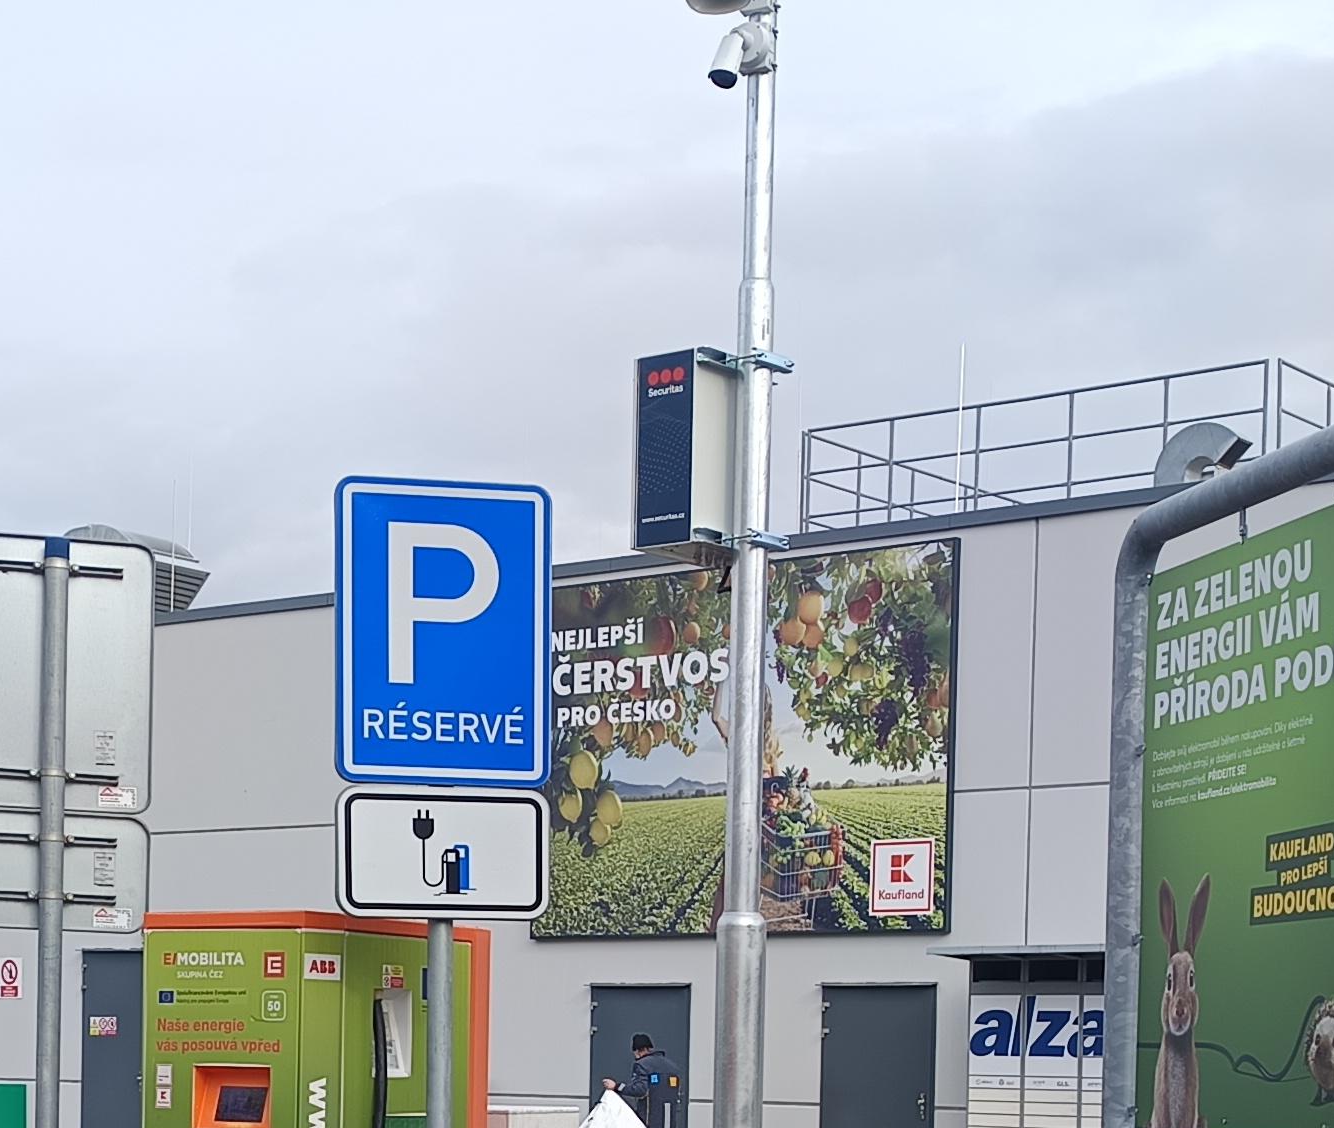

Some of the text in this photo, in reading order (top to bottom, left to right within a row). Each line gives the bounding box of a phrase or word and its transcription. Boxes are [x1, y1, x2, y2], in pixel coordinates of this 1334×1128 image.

[648, 384, 684, 397] Securitas
[1156, 539, 1312, 631] ZA ZELENOU
[388, 521, 500, 684] P
[552, 617, 644, 652] NEJLEPŠÍ
[1155, 590, 1319, 680] ENERGII VÁM
[552, 648, 730, 696] ČERSTVOS
[1153, 664, 1267, 729] PŘÍRODA
[363, 702, 524, 744] RÉSERVÉ
[557, 698, 677, 728] PRO ČESKO
[1269, 832, 1334, 862] KAUFLAND
[1280, 855, 1328, 887] PRO LEPŠÍ
[878, 888, 924, 900] Kaufland
[176, 968, 224, 979] SKUPINA ČEZ
[309, 960, 336, 974] ABB
[267, 1001, 281, 1011] 50
[157, 1018, 245, 1034] Naše energie
[156, 1037, 281, 1054] vás posouvá vpřed
